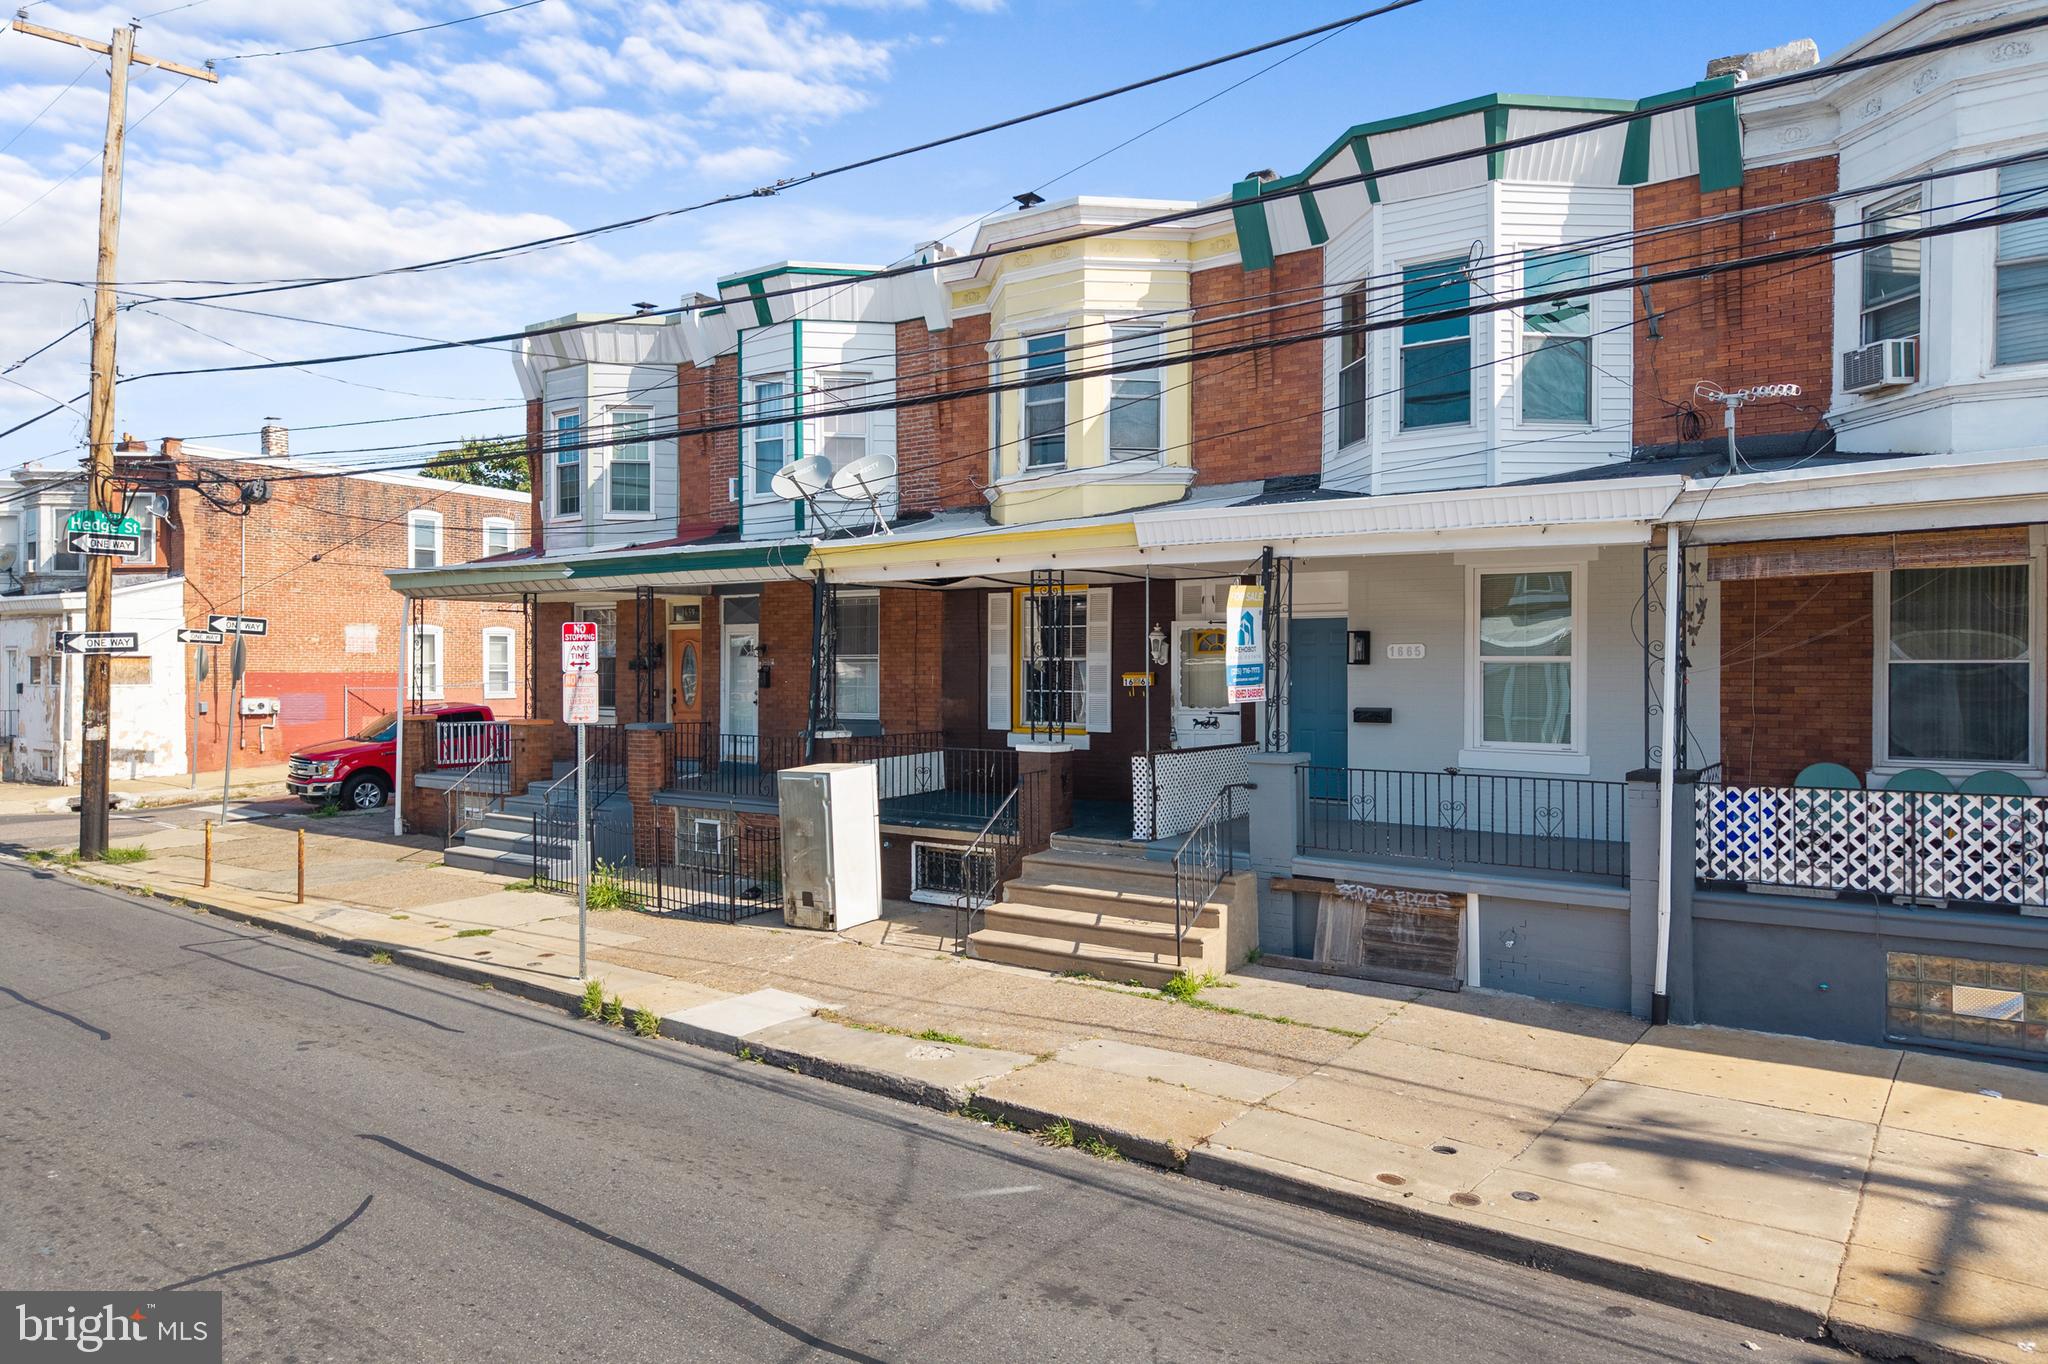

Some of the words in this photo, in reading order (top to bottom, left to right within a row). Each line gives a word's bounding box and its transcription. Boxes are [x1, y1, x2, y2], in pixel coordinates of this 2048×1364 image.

[70, 517, 118, 533] Hedge
[124, 522, 138, 534] St
[90, 539, 110, 549] ONE
[113, 540, 131, 550] WAY
[1246, 592, 1264, 601] SALE
[226, 621, 240, 630] ON
[573, 624, 586, 634] NO
[565, 633, 595, 641] STOPPING
[86, 639, 107, 647] ONE
[110, 638, 130, 647] WAY
[571, 652, 590, 660] TIME
[1391, 646, 1421, 657] 1665
[565, 675, 576, 686] NO
